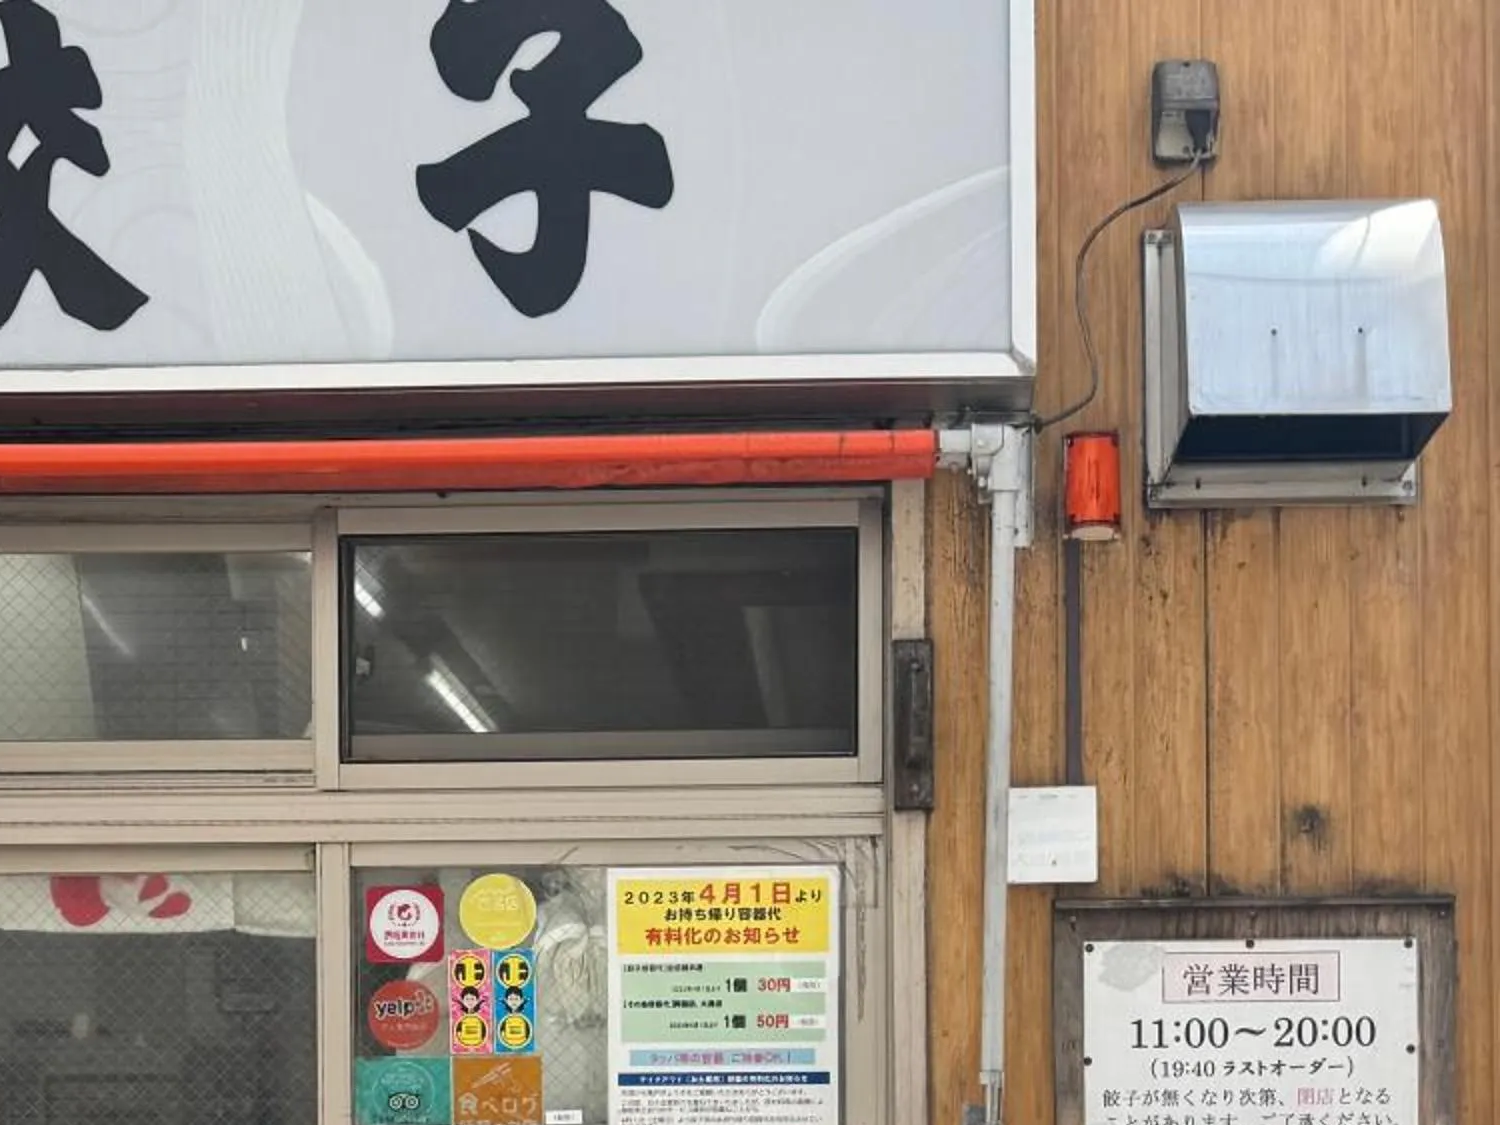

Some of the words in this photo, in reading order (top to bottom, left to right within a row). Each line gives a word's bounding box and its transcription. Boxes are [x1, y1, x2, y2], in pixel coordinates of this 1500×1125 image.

[664, 907, 781, 922] お持ち帰り容器代
[645, 927, 800, 945] 有料化のお知らせ
[757, 978, 791, 993] 30円
[1183, 963, 1319, 996] 営業時間
[373, 996, 414, 1020] yelp
[756, 1014, 789, 1029] 50円
[458, 1091, 538, 1116] 食べログ
[1102, 1086, 1392, 1109] 餃子が無くなり次第、閉店となる
